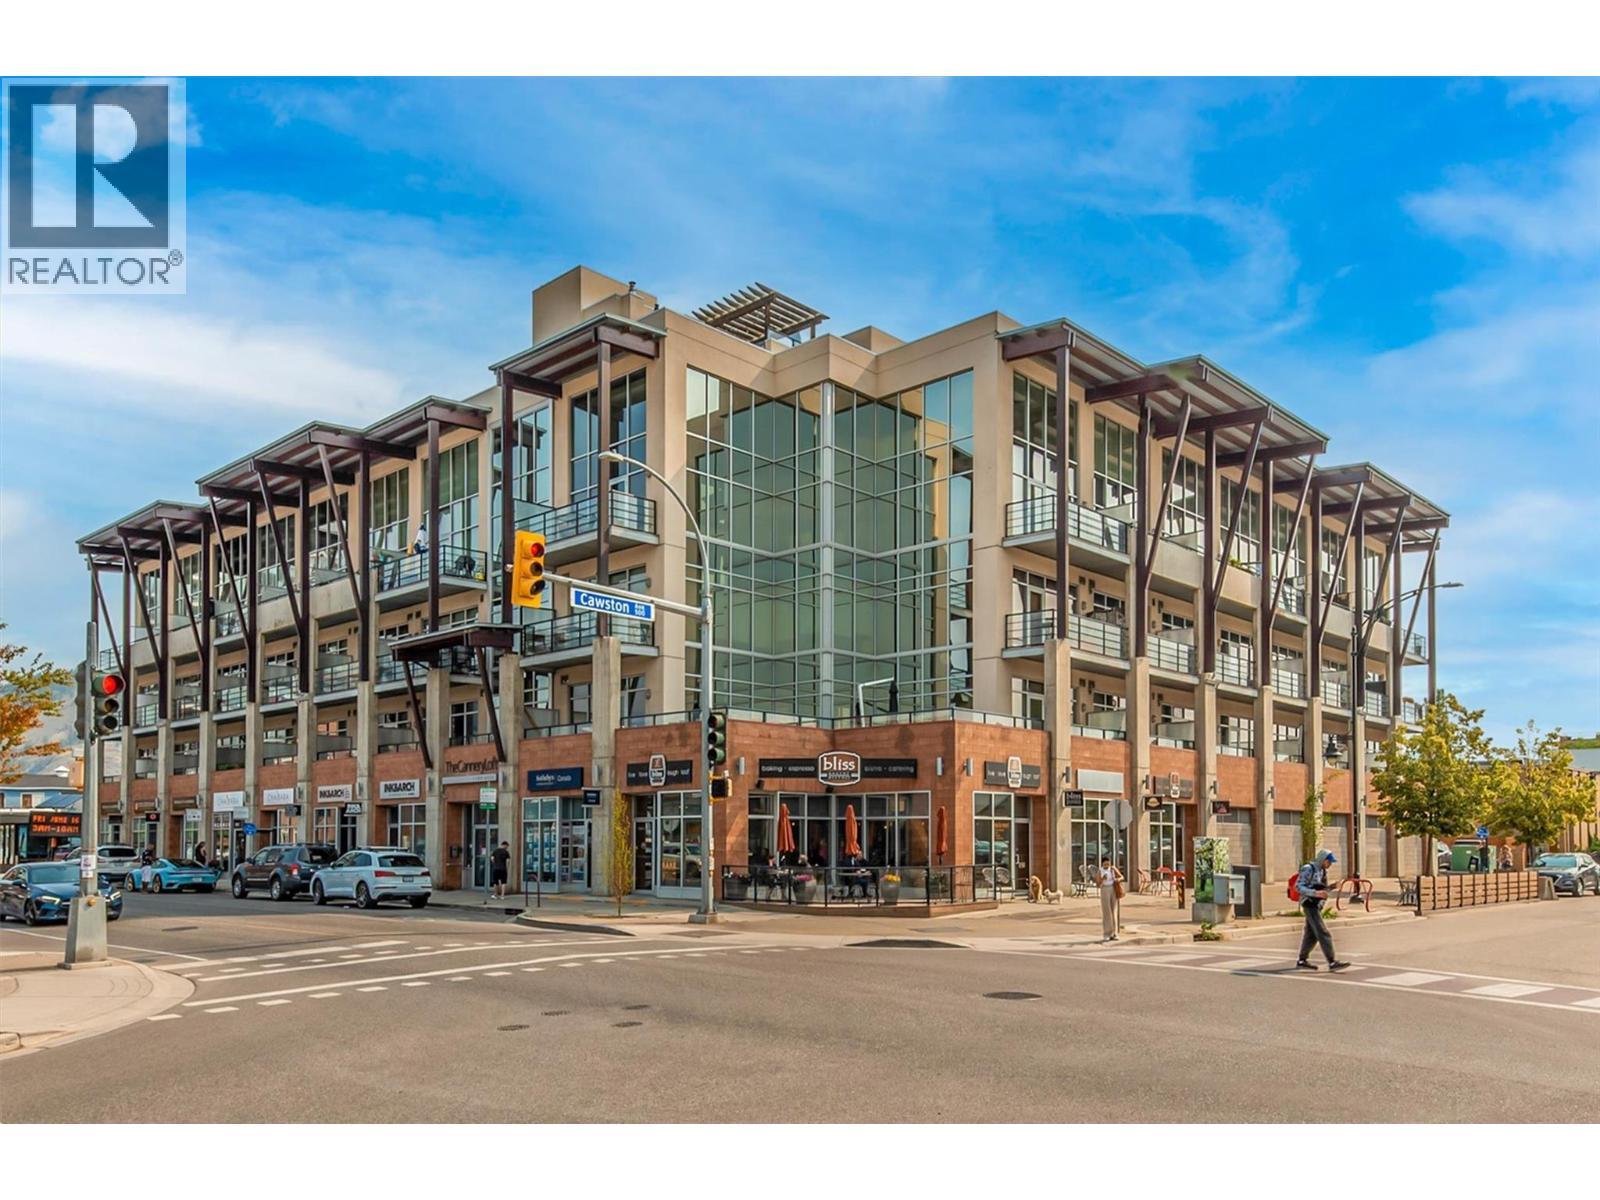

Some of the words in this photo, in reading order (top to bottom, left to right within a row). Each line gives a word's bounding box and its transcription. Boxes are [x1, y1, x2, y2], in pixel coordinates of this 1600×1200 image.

[580, 593, 630, 614] Cawston
[823, 756, 856, 771] bliss
[788, 765, 815, 773] espresso
[888, 765, 914, 773] catering
[32, 815, 46, 823] FRI
